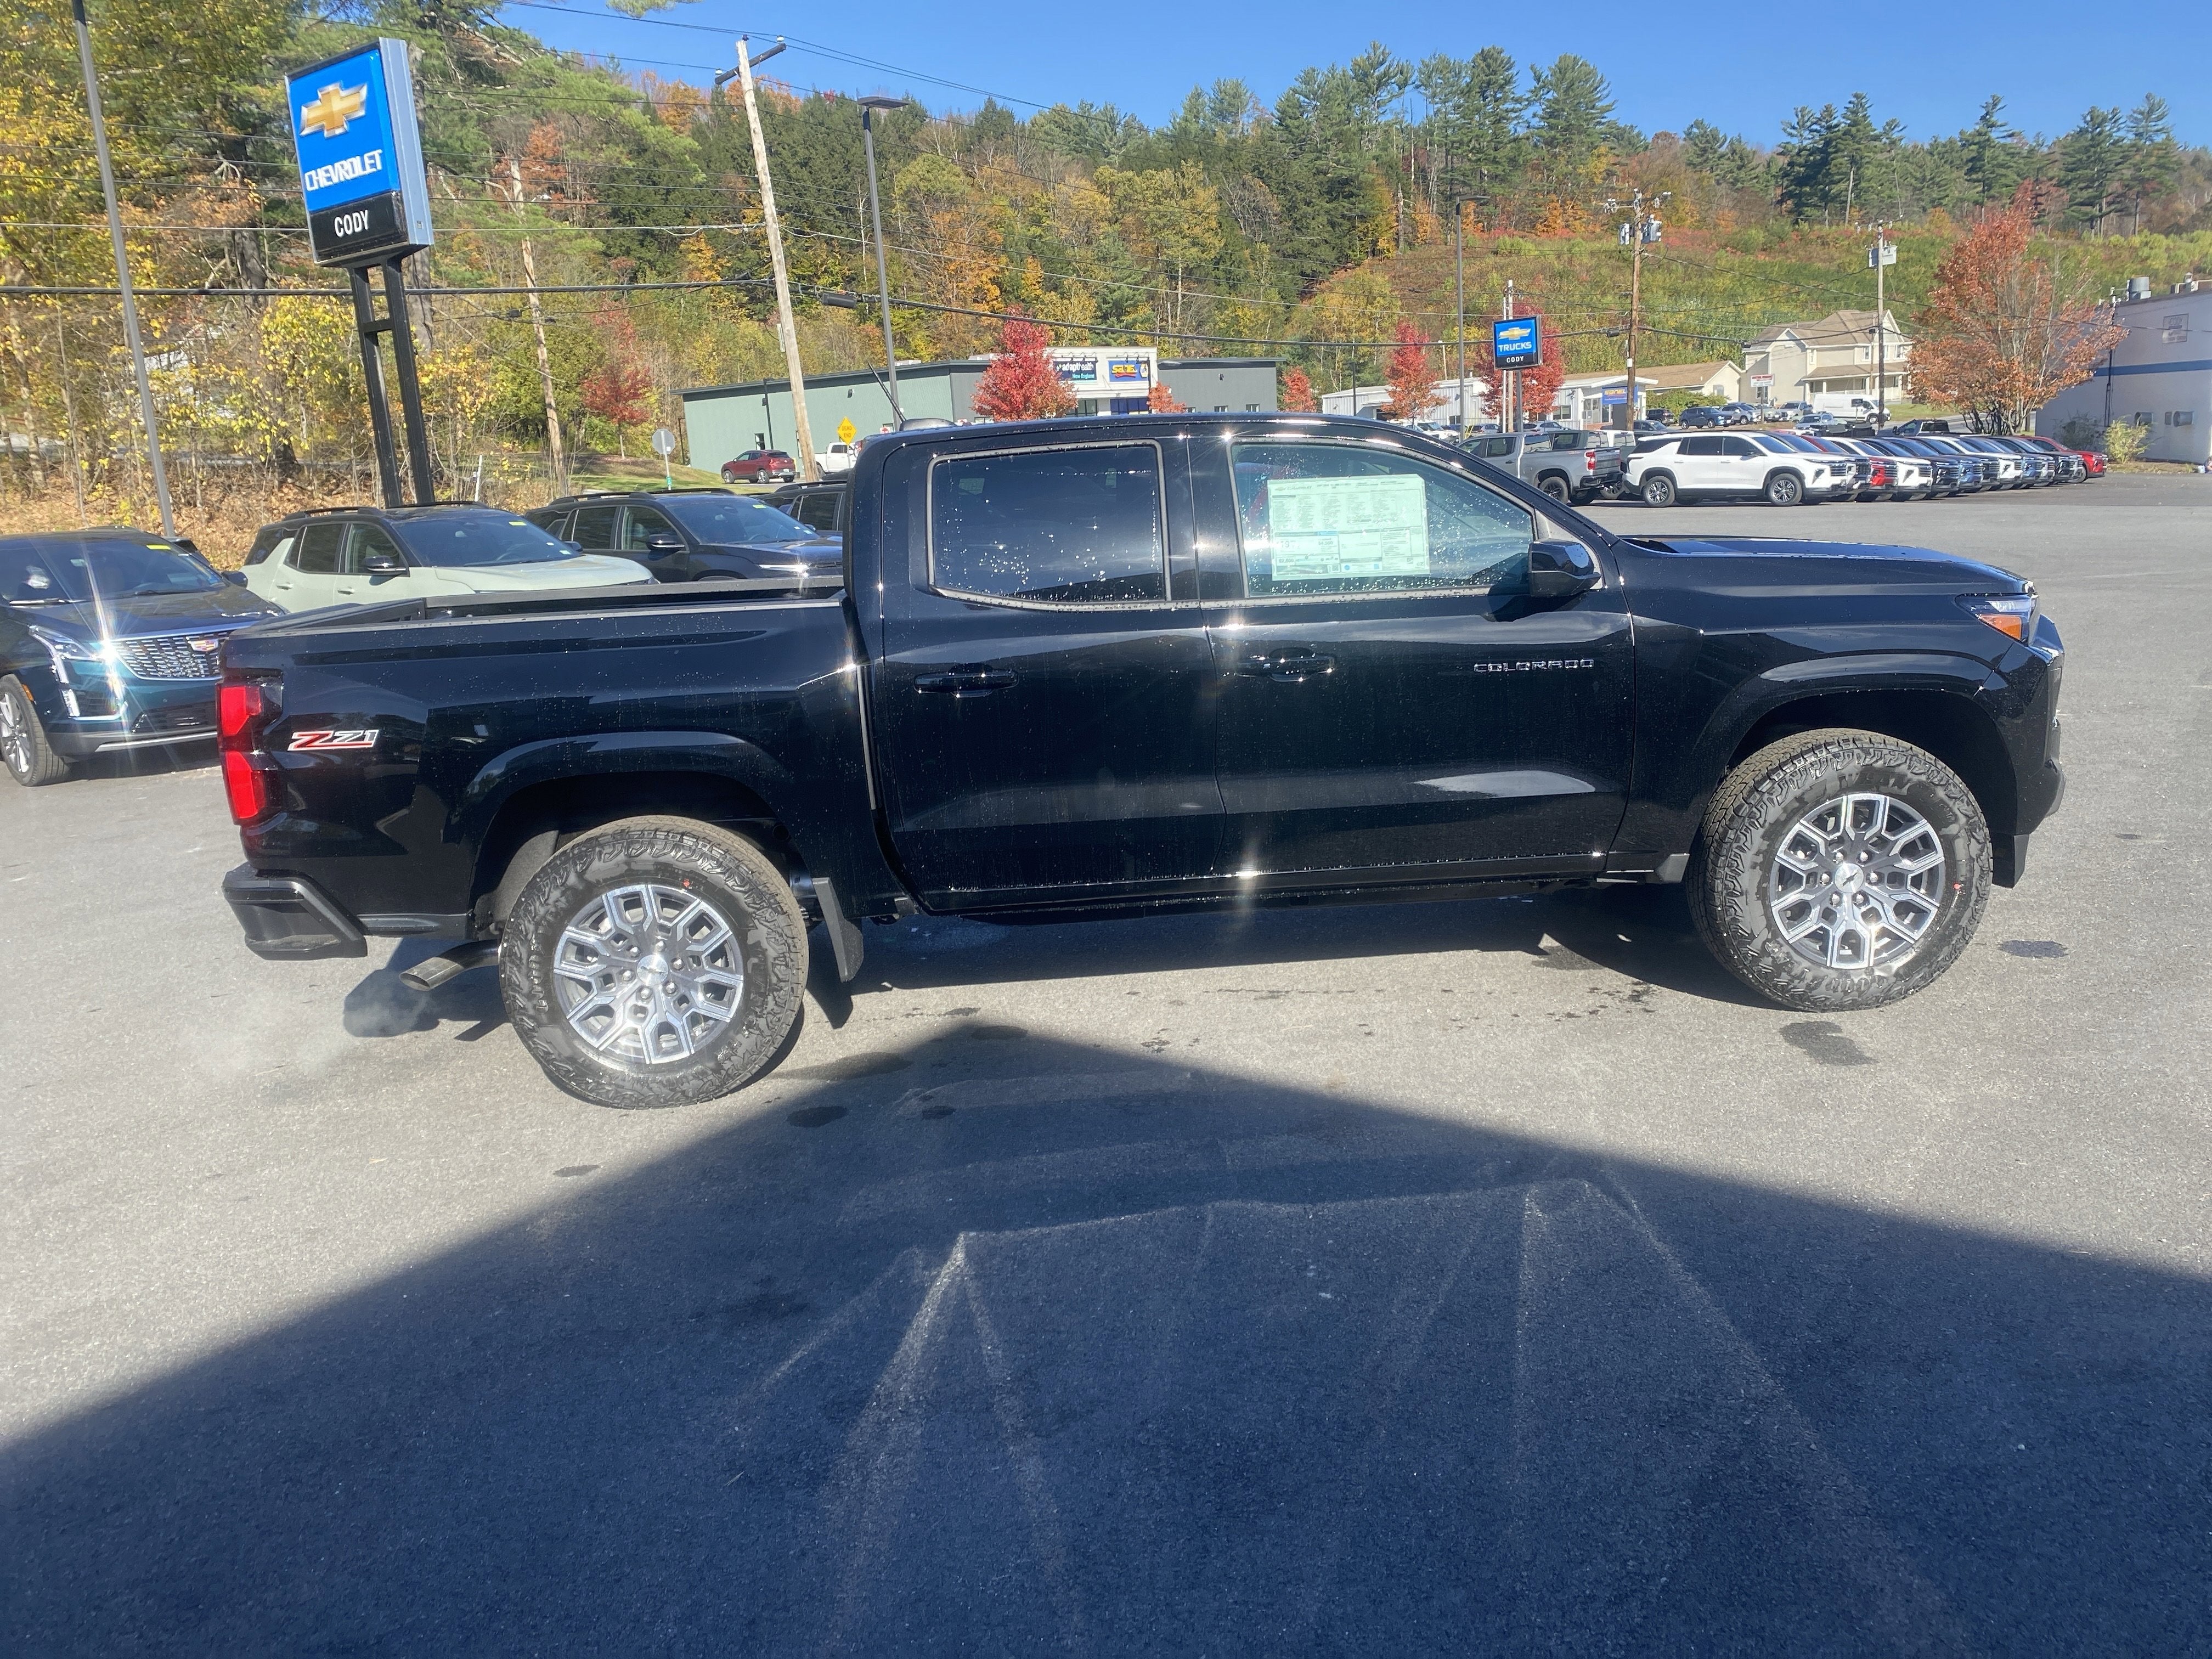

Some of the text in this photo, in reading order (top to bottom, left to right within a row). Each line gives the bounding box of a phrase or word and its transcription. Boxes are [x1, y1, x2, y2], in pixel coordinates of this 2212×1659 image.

[304, 149, 382, 191] CHEVROLET
[334, 209, 369, 238] CODY
[1498, 341, 1532, 352] TRUCKS
[1474, 659, 1594, 672] COLORADO
[287, 730, 379, 751] Z71
